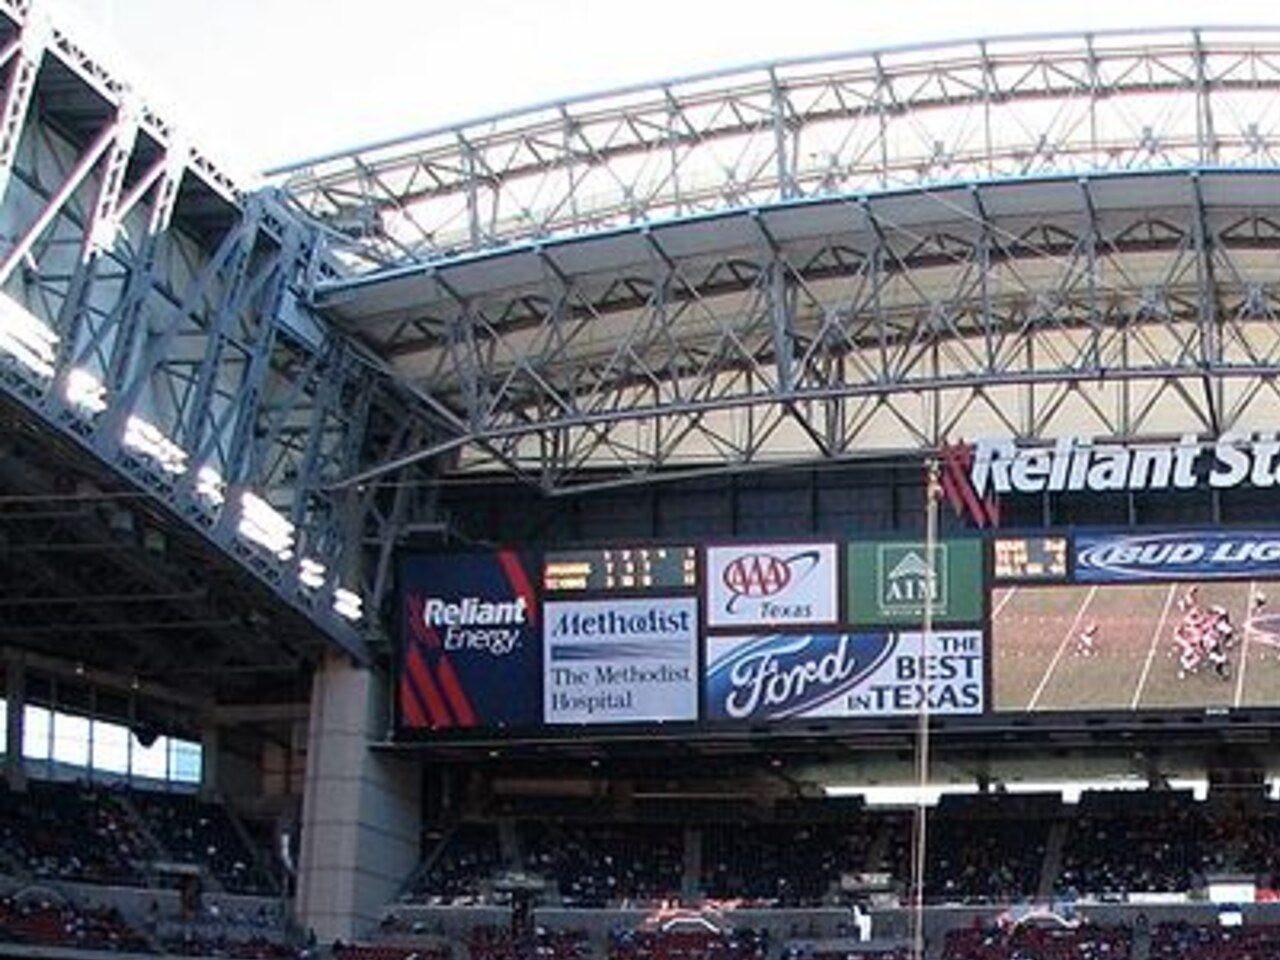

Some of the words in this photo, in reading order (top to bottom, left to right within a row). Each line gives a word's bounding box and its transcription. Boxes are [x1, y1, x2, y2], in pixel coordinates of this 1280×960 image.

[971, 436, 1201, 497] Reliant
[729, 555, 784, 596] AAA
[886, 579, 938, 601] AIM
[424, 597, 526, 627] Reliant
[760, 602, 813, 618] Texas
[553, 610, 690, 638] Methodist
[938, 636, 979, 652] THE
[552, 667, 589, 687] The
[595, 665, 691, 686] Methodist
[726, 635, 855, 718] Ford
[896, 655, 980, 680] BEST
[552, 691, 633, 714] Hospital
[849, 693, 871, 710] IN
[870, 683, 981, 709] TEXAS
